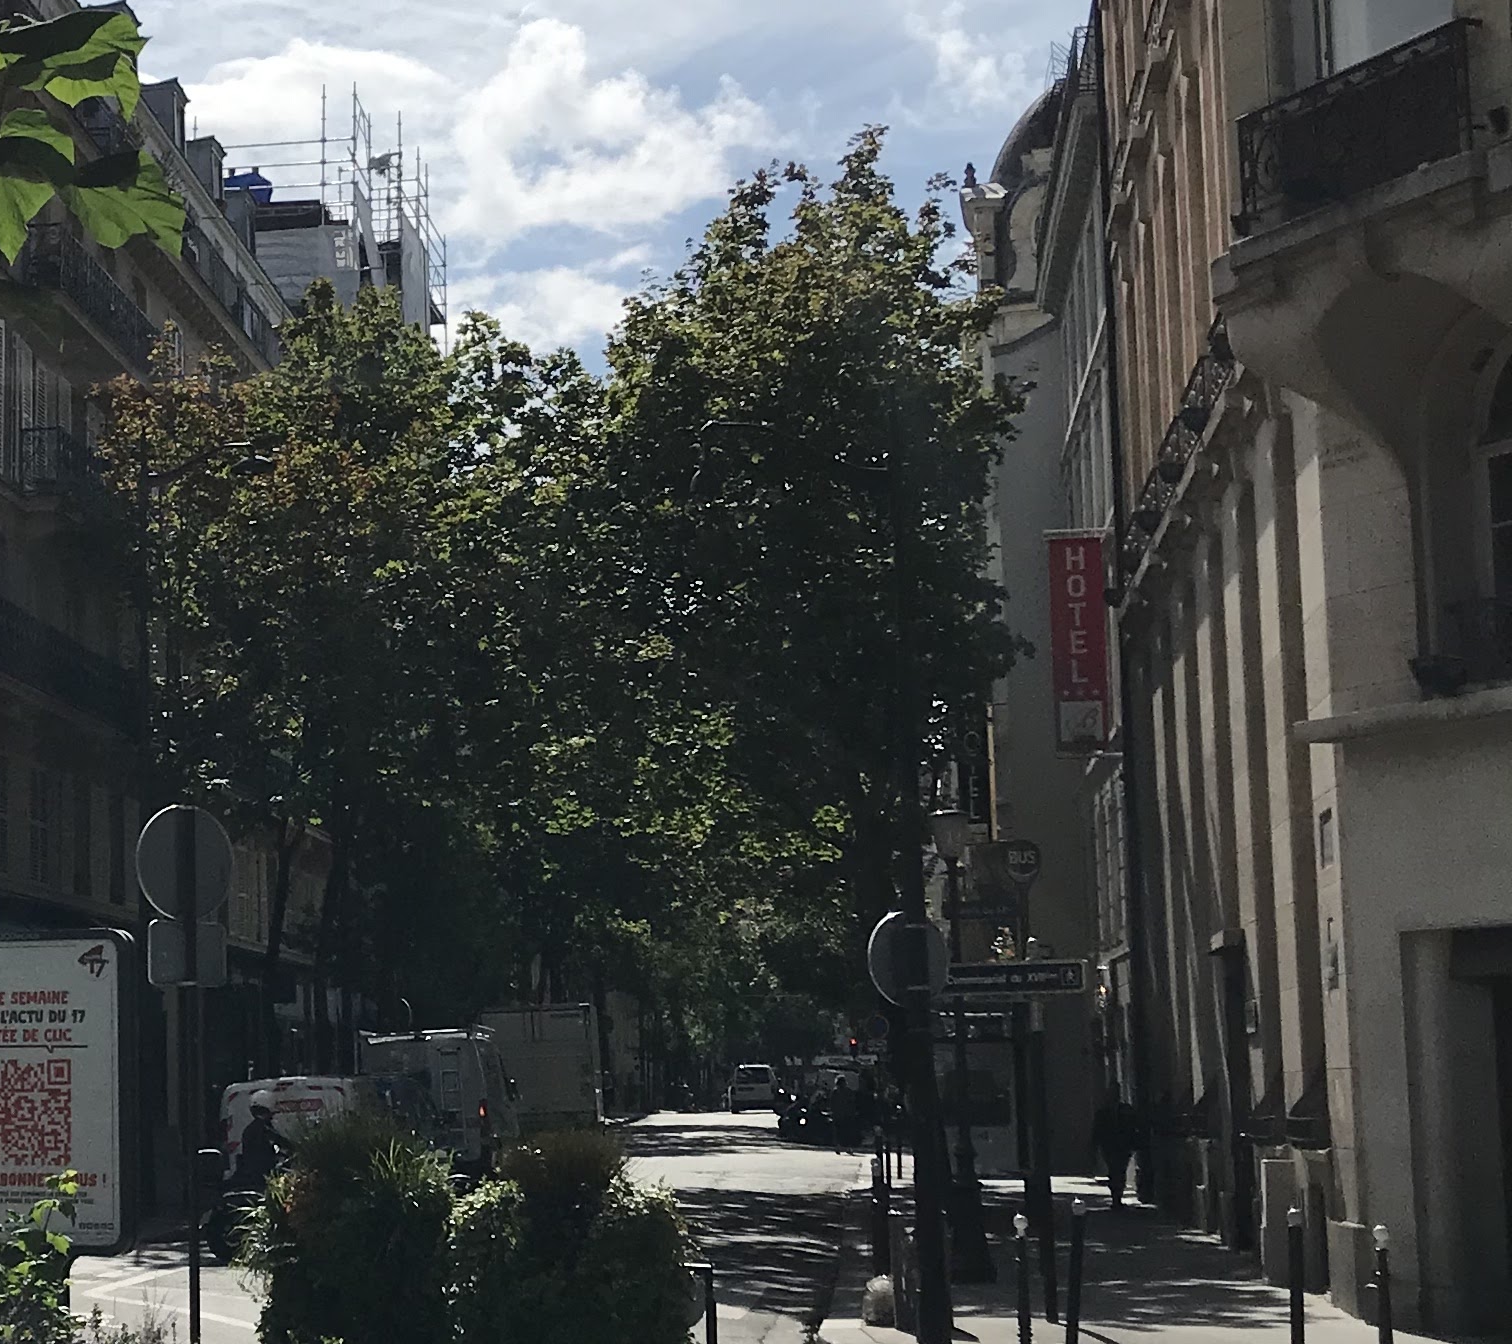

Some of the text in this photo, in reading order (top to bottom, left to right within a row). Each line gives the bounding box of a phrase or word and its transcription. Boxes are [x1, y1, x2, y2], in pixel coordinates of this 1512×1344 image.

[1065, 545, 1089, 684] HOTEL
[1008, 850, 1036, 864] BUS
[10, 990, 70, 1005] SEMAINE
[0, 1009, 43, 1024] L'ACTU
[48, 1009, 66, 1024] DU
[71, 1009, 86, 1024] 17
[23, 1028, 38, 1042] DE
[44, 1028, 72, 1042] CLIC
